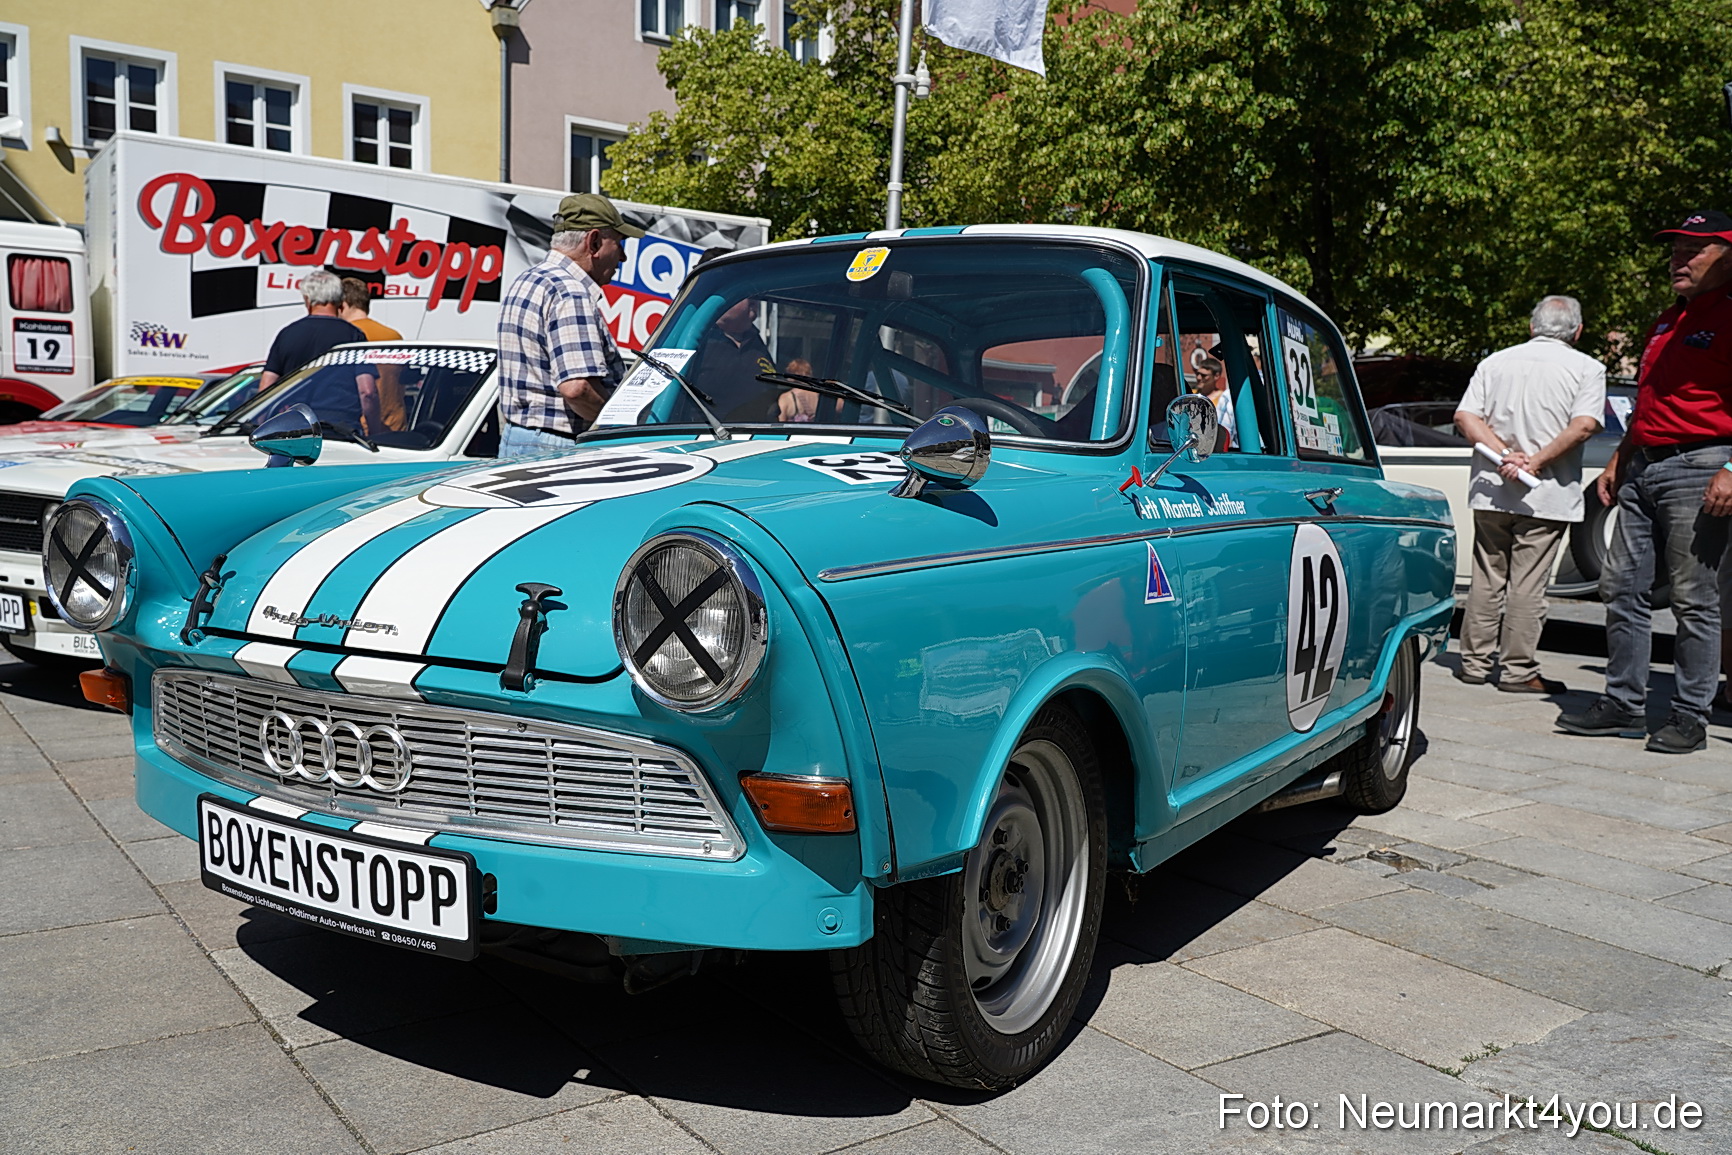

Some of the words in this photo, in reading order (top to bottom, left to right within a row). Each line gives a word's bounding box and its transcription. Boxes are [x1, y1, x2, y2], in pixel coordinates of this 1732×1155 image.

[138, 173, 504, 313] Boxenstopp
[266, 272, 420, 297] Licnau
[611, 237, 703, 300] IQ
[140, 331, 187, 349] KW
[597, 294, 670, 346] MO
[27, 337, 61, 360] 19
[1289, 347, 1317, 409] 32
[468, 456, 693, 504] 42
[808, 455, 910, 480] 32
[1158, 495, 1204, 518] Mantzel
[1202, 493, 1247, 516] Schöffner
[0, 598, 20, 624] PP
[1294, 553, 1338, 703] 42
[73, 636, 96, 649] BILS
[207, 811, 458, 926] BOXENSTOPP
[221, 882, 255, 903] Boxenstopp
[254, 895, 285, 913] Lichtenau
[288, 906, 318, 923] Oldtimer
[319, 916, 376, 938] Auto-Werkstatt
[391, 933, 437, 951] 08450/466
